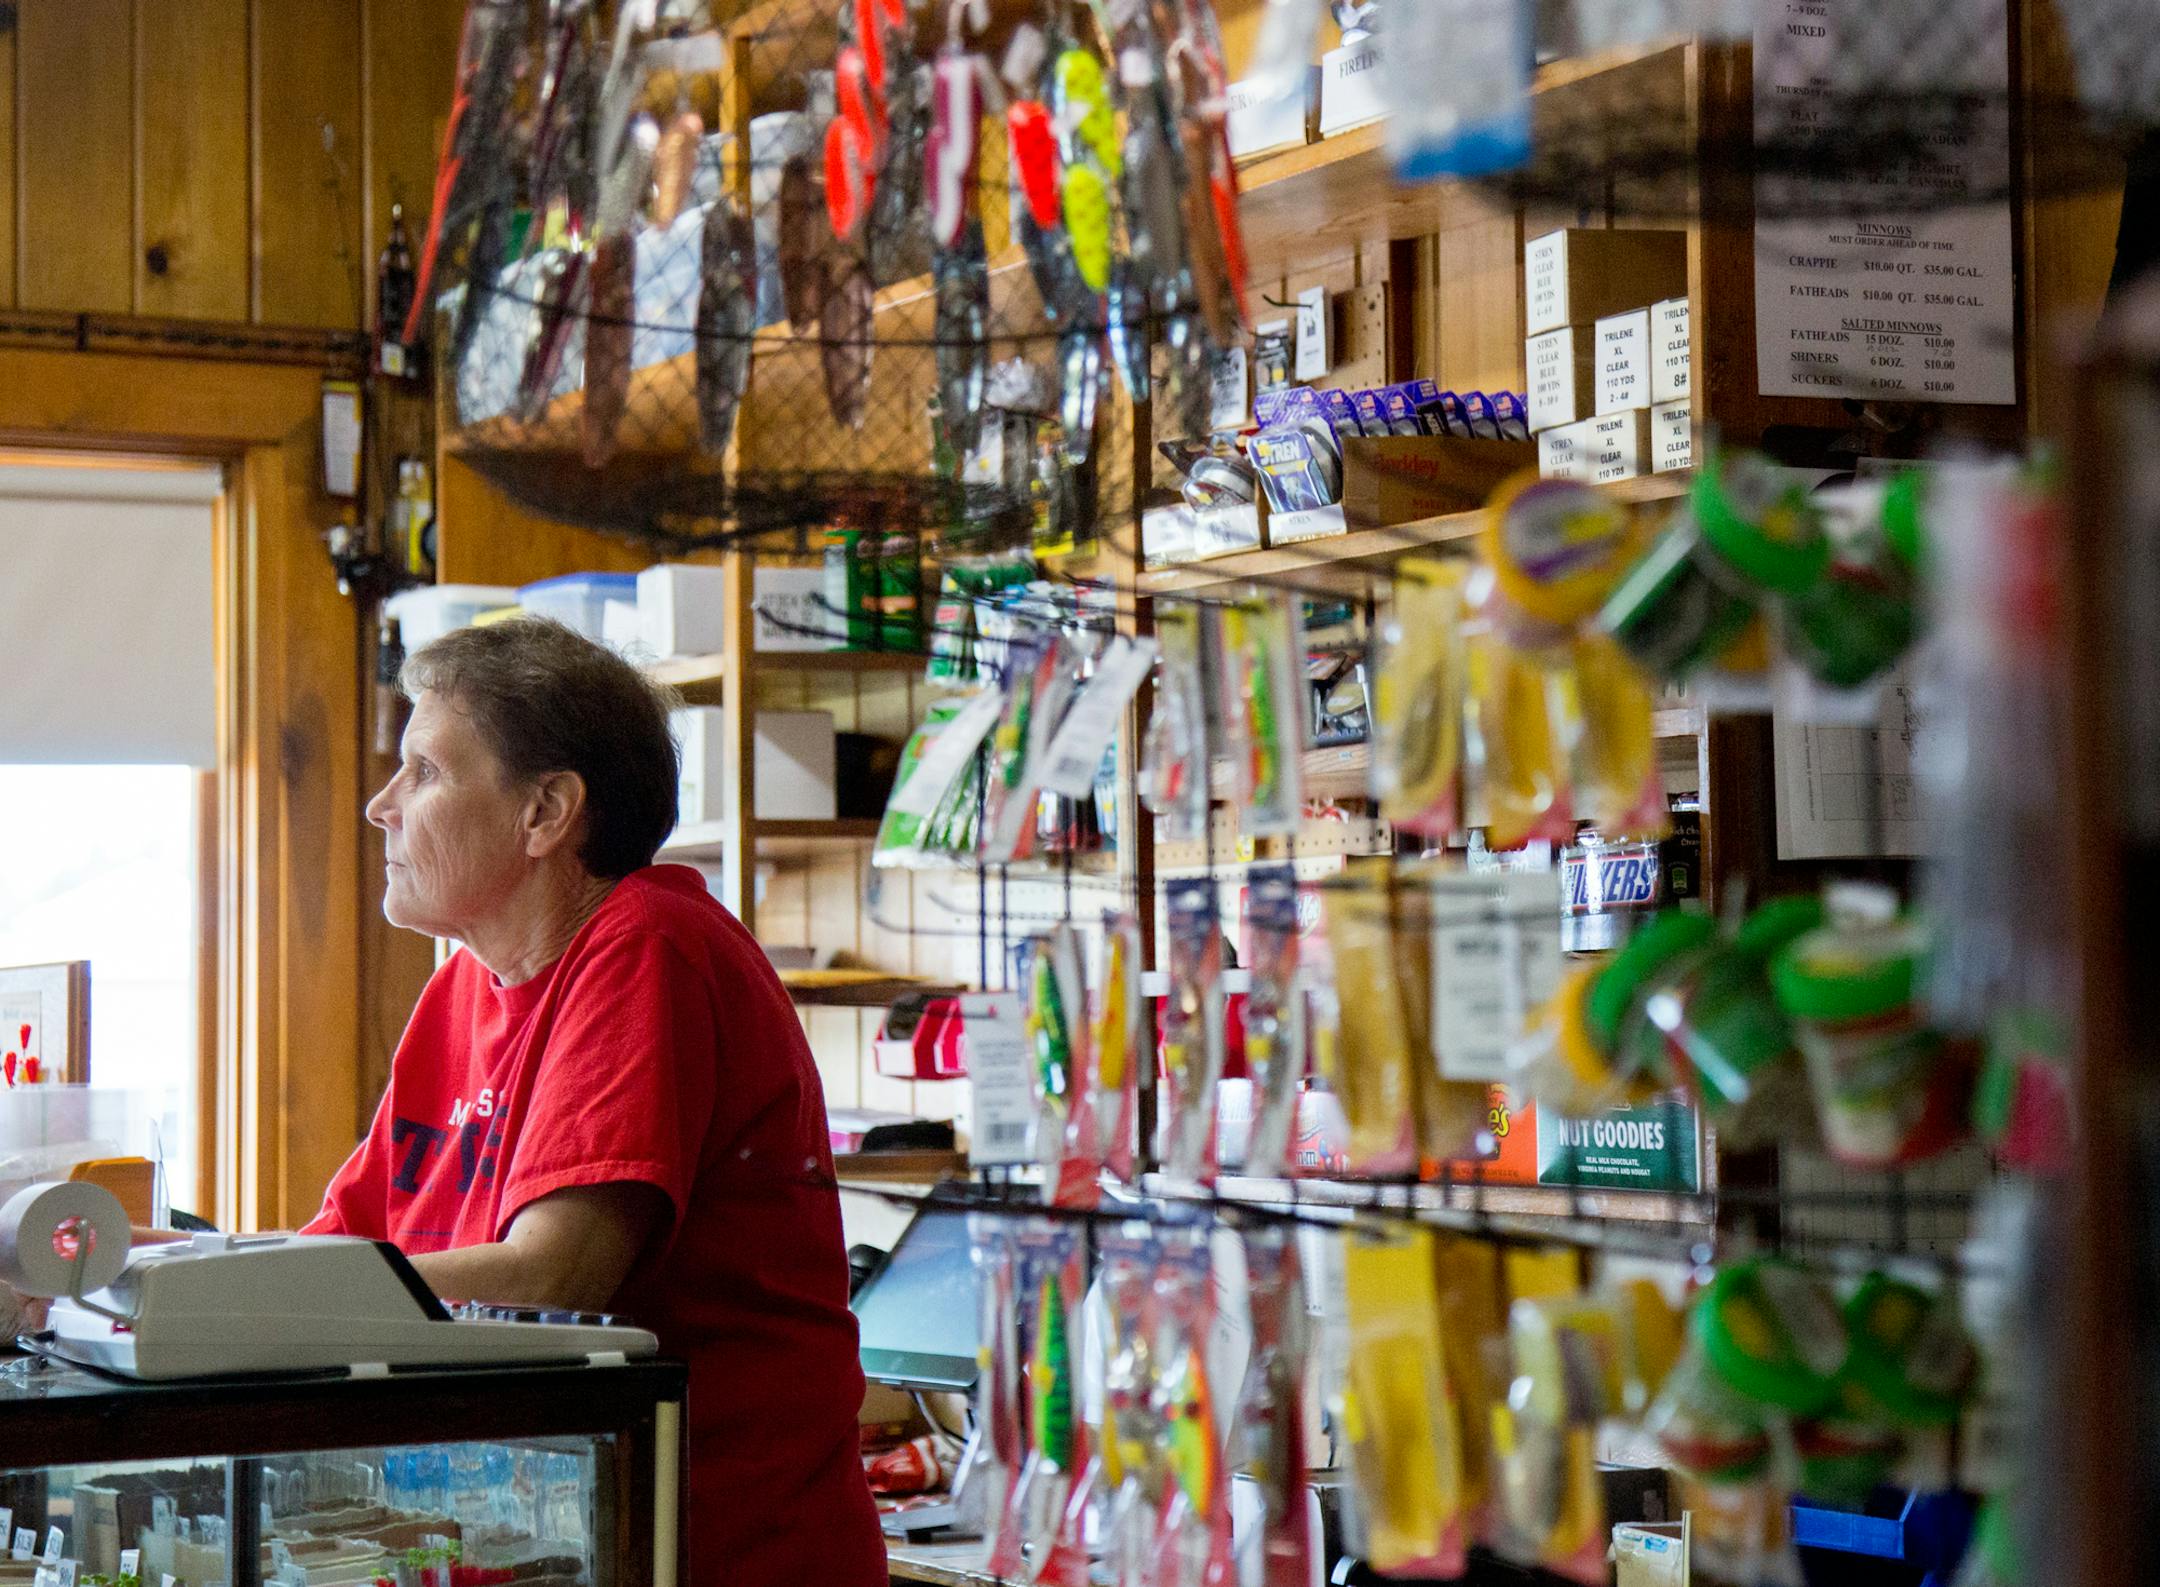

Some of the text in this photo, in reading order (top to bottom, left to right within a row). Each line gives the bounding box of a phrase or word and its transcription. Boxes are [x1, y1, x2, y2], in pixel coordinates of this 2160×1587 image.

[1786, 24, 1826, 38] MIXED
[1856, 223, 1912, 236] MINNOWS
[1829, 234, 1954, 251] MUST ORDER AHEAD OF TIME
[1534, 261, 1554, 275] CLEAR
[1789, 255, 1983, 278] CRAPPIE $10.00 QT. $35.00 GAL.
[1789, 285, 1984, 307] FATHEADS $10.00 QT. $35.00 GAL.
[1664, 308, 1689, 321] TRILEN
[1674, 325, 1684, 334] XL
[1841, 318, 1942, 334] SALTED MINNOWS
[1605, 328, 1633, 342] TRILENE
[1791, 329, 1955, 349] FATHEADS 15 DOZ. $10.00
[1537, 337, 1559, 351] STREN
[1614, 347, 1623, 356] XL
[1537, 352, 1559, 366] CLEAR
[1666, 354, 1690, 367] 110 YD
[1791, 352, 1955, 370] SHINERS 6 DOZ. $10.00
[1540, 366, 1556, 379] BLUE
[1606, 360, 1629, 373] CLEAR
[1606, 375, 1635, 389] 110 YDS
[1674, 373, 1687, 387] 8#
[1791, 374, 1955, 392] SUCKERS 6 DOZ. $10.00
[1596, 419, 1623, 433] TRILENE
[1673, 427, 1682, 435] XL
[1550, 438, 1573, 451] STREN
[1606, 438, 1614, 447] XL
[1667, 441, 1690, 453] CLEAR
[1550, 453, 1574, 466] CLEAR
[1600, 451, 1622, 464] CLEAR
[1665, 458, 1676, 468] 110
[1599, 466, 1625, 479] 110 YDS
[1566, 858, 1651, 905] ICKERS
[1558, 1118, 1665, 1151] NUT GOODIES
[1585, 1156, 1598, 1164] REAL
[1610, 1157, 1640, 1167] CHOCOLATE,
[1598, 1166, 1619, 1174] PEANUTS
[1631, 1168, 1651, 1176] NOUGAT
